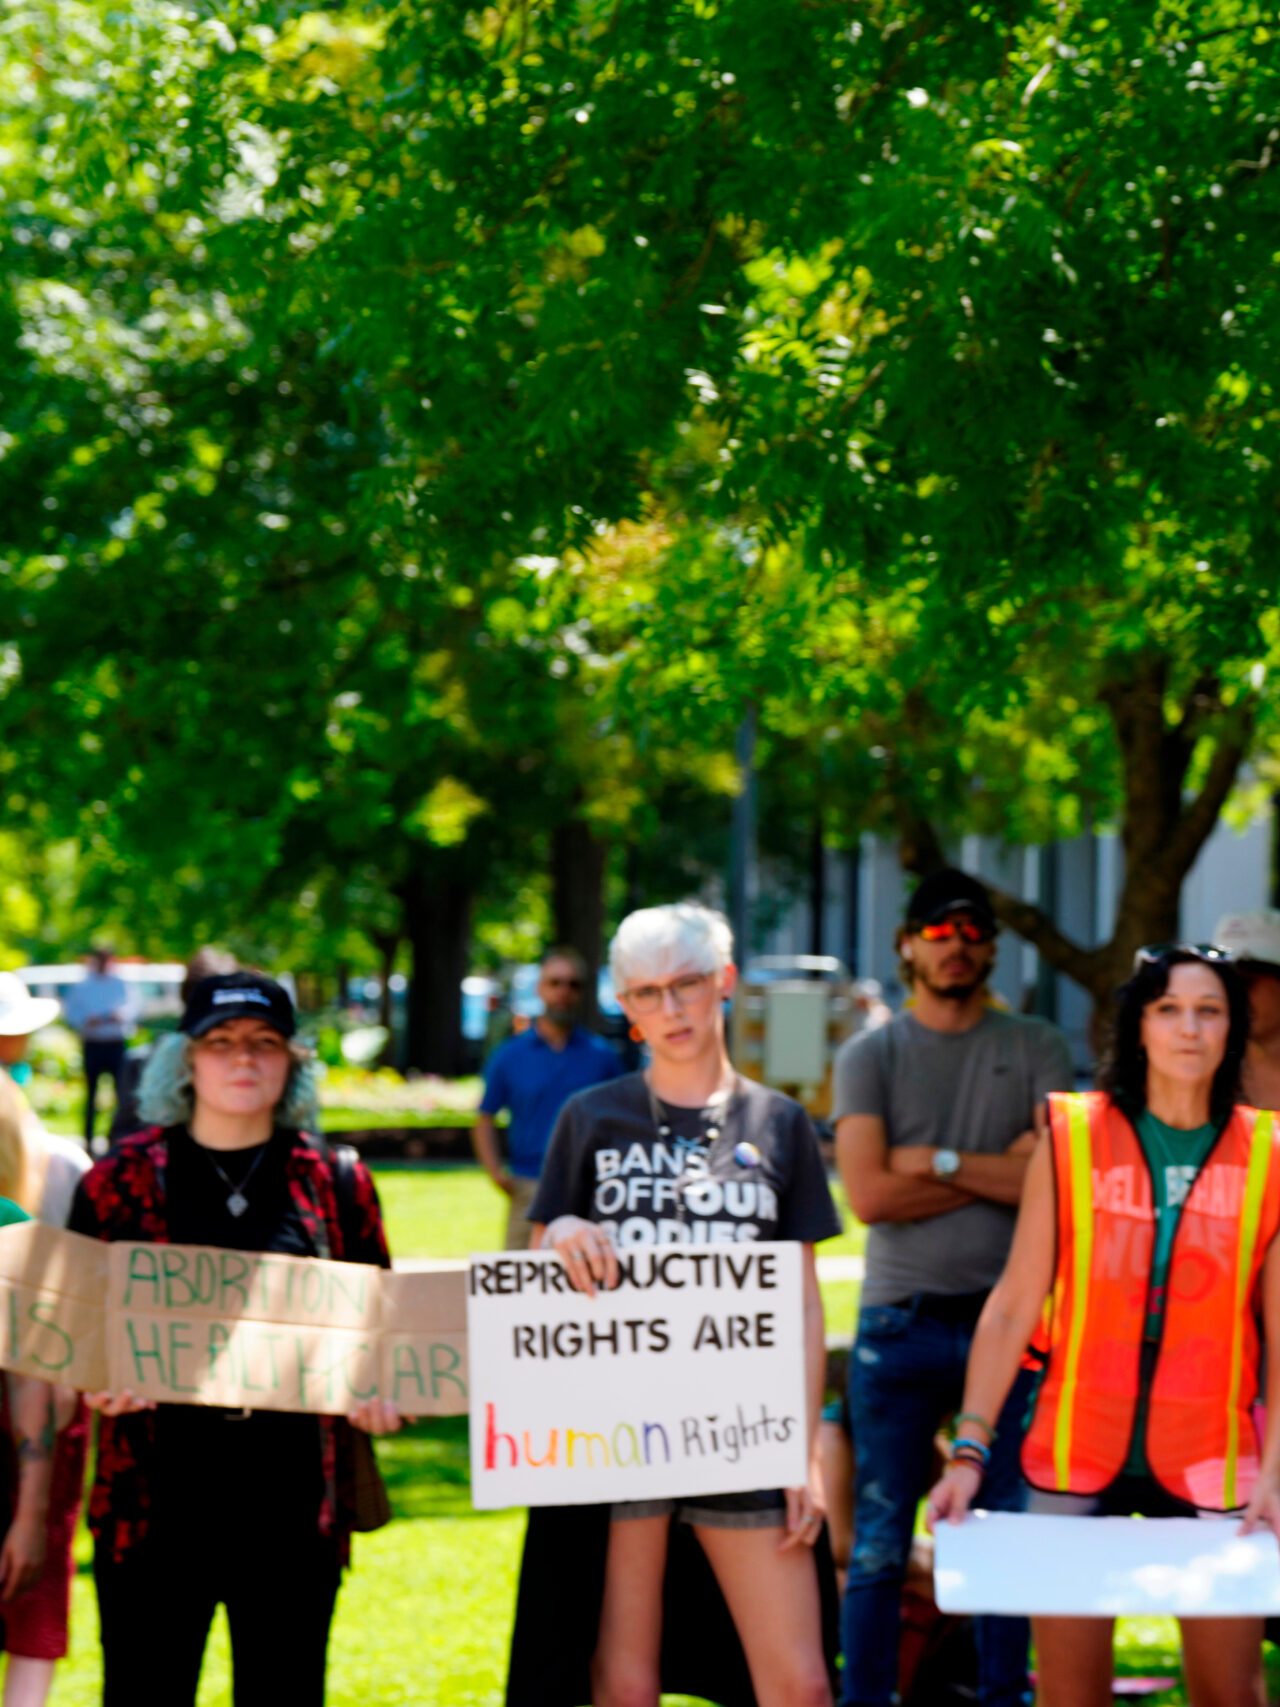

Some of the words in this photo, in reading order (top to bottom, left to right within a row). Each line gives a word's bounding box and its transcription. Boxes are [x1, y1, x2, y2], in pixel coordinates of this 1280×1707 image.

[595, 1142, 710, 1181] BANS
[595, 1177, 677, 1214] OFF
[684, 1180, 777, 1221] OUR
[123, 1247, 367, 1315] ABORTION
[7, 1289, 74, 1370] IS
[125, 1318, 468, 1406] HEALTHCAR
[514, 1318, 670, 1359] RIGHTS
[693, 1312, 775, 1351] ARE
[484, 1402, 670, 1470] human
[681, 1404, 797, 1463] Rights
